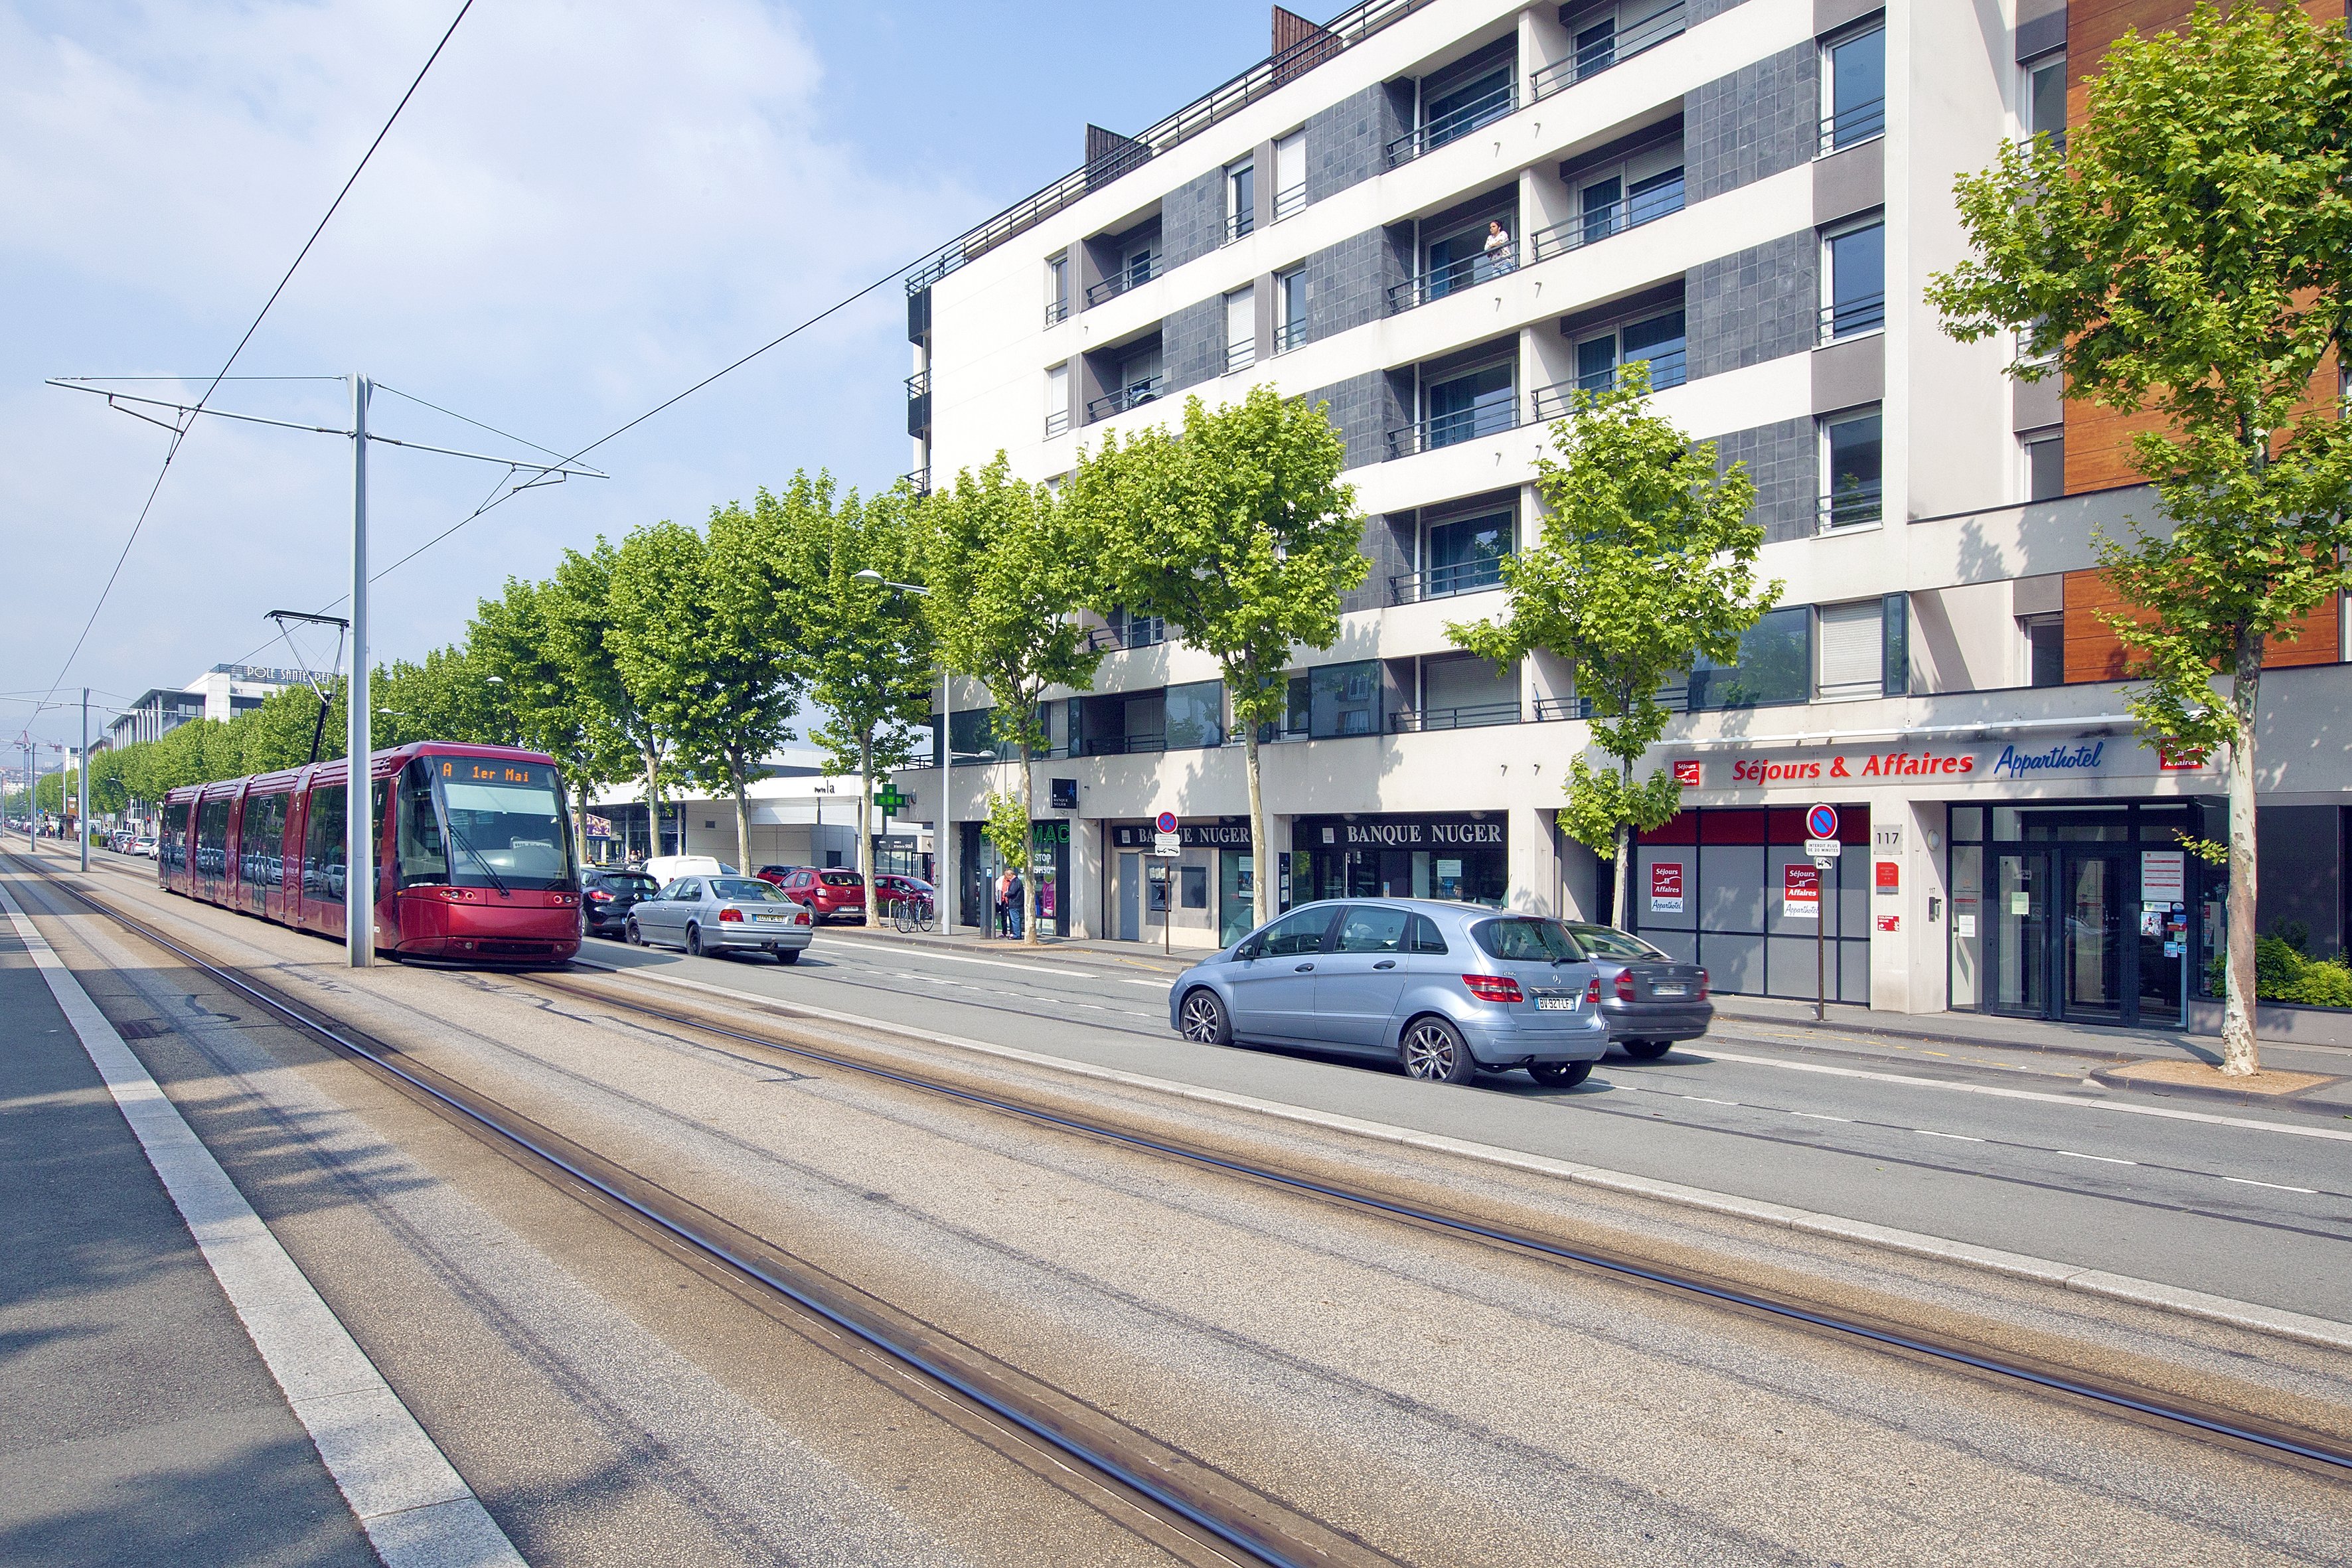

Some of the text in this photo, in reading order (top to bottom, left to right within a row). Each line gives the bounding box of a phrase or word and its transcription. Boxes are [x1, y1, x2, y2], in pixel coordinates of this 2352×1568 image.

[1733, 741, 2104, 785] Séjours & Affaires Apparthotel
[443, 762, 528, 782] A 1er Mai
[1200, 827, 1250, 842] NUGER
[1347, 824, 1502, 845] BANQUE NUGER
[1877, 832, 1899, 844] 117
[1652, 900, 1682, 911] Apparthotel
[1539, 997, 1569, 1009] BV-927-LF
